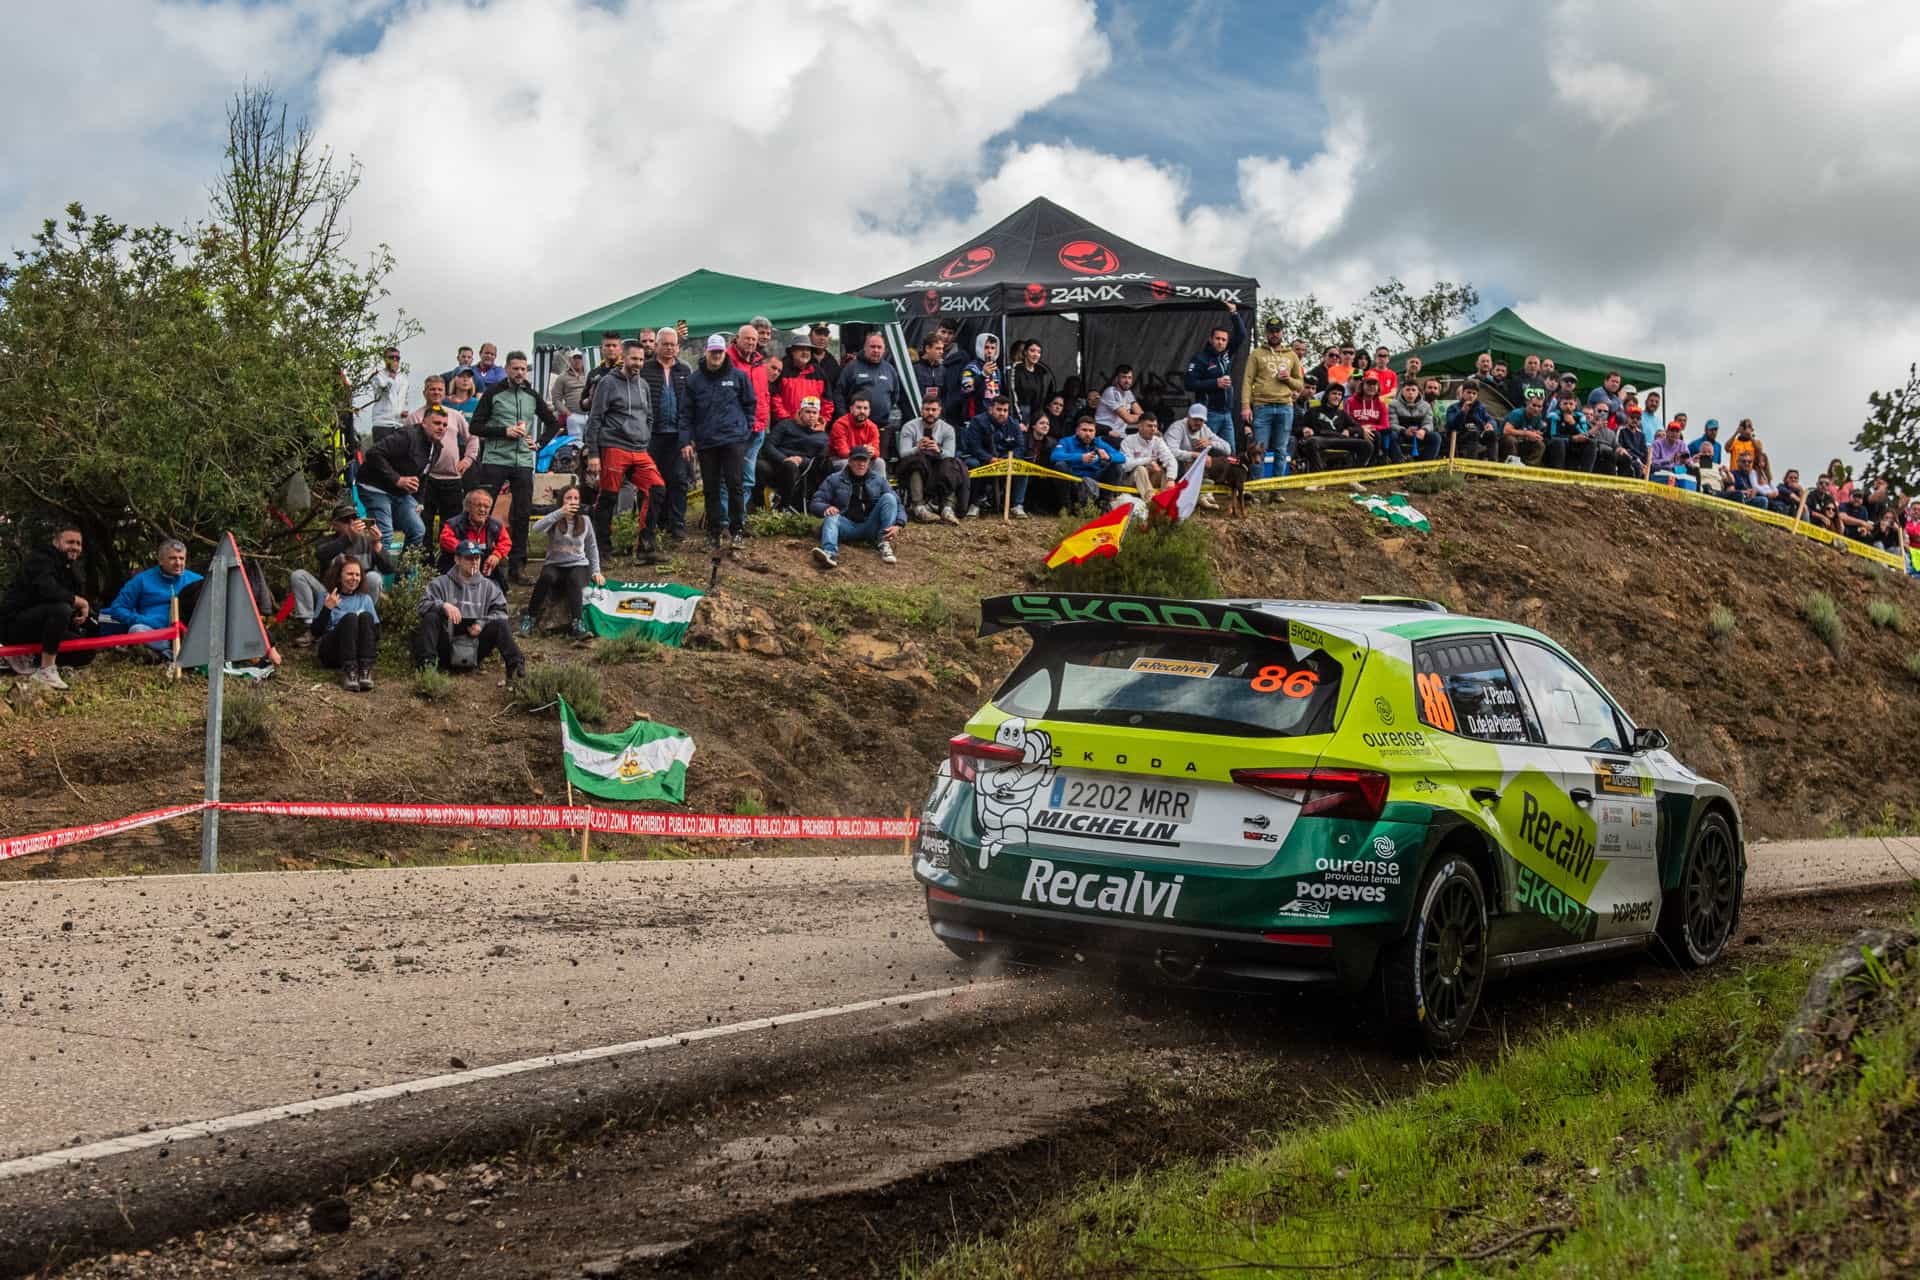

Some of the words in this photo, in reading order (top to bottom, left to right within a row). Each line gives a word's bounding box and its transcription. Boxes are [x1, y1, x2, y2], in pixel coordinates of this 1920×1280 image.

[939, 296, 990, 312] 24MX
[1050, 284, 1125, 304] 24MX
[1175, 286, 1242, 303] 24MX
[1250, 665, 1320, 699] 86
[1416, 672, 1456, 733] 86
[1362, 731, 1425, 747] ourense
[1067, 781, 1132, 812] 2202
[1138, 788, 1190, 818] MRR
[477, 807, 511, 826] PROHIBIDO
[513, 807, 540, 826] PUBLICO
[542, 808, 560, 826] ZONA
[610, 814, 628, 830] ZONA
[631, 815, 667, 831] PROHIBIDO
[668, 816, 696, 833] PUBLICO
[699, 817, 716, 833] ZONA
[718, 818, 751, 834] PROHIBIDO
[754, 818, 781, 834] PUBLICO
[783, 819, 800, 834] ZONA
[802, 819, 834, 835] PROHIBIDO
[836, 820, 862, 835] PUBLICO
[864, 821, 881, 835] ZONA
[1032, 810, 1178, 840] MICHELIN
[1519, 790, 1595, 884] Recalvi
[1315, 858, 1400, 876] ourense
[1325, 871, 1369, 883] provincia
[1371, 873, 1401, 885] termal
[1021, 858, 1185, 919] Recalvi
